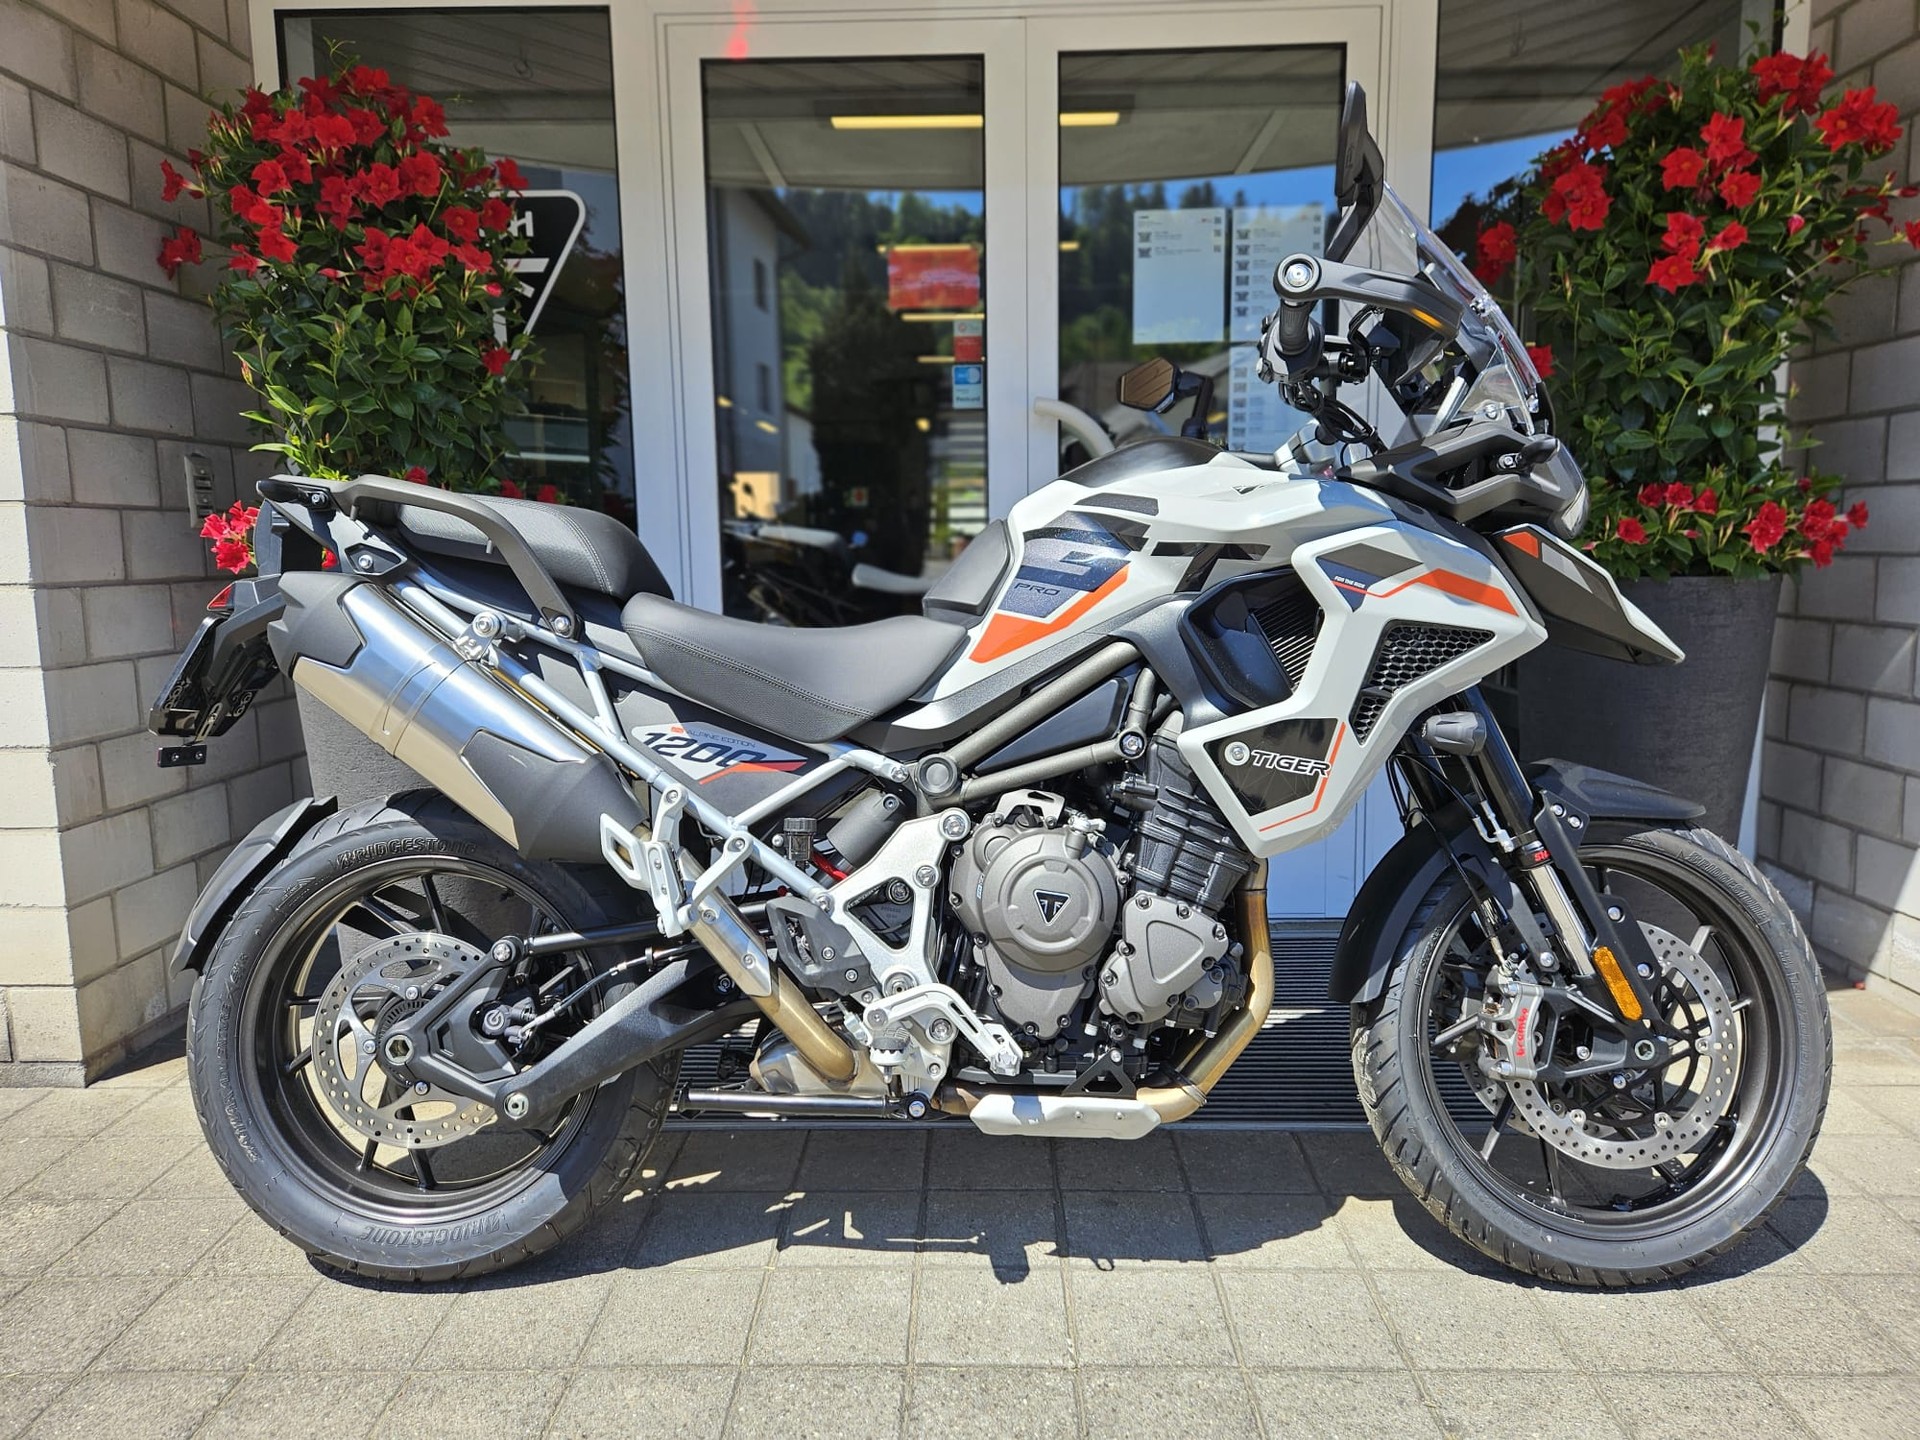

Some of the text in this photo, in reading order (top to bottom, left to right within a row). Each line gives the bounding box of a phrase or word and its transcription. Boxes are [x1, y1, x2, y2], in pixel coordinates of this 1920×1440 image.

[1014, 582, 1061, 596] PRO
[643, 732, 767, 768] 1200
[687, 729, 756, 749] ALPINE EDITION
[1251, 749, 1332, 778] TIGER
[336, 837, 477, 870] BRIDGESTONE
[1515, 1007, 1529, 1058] brembo
